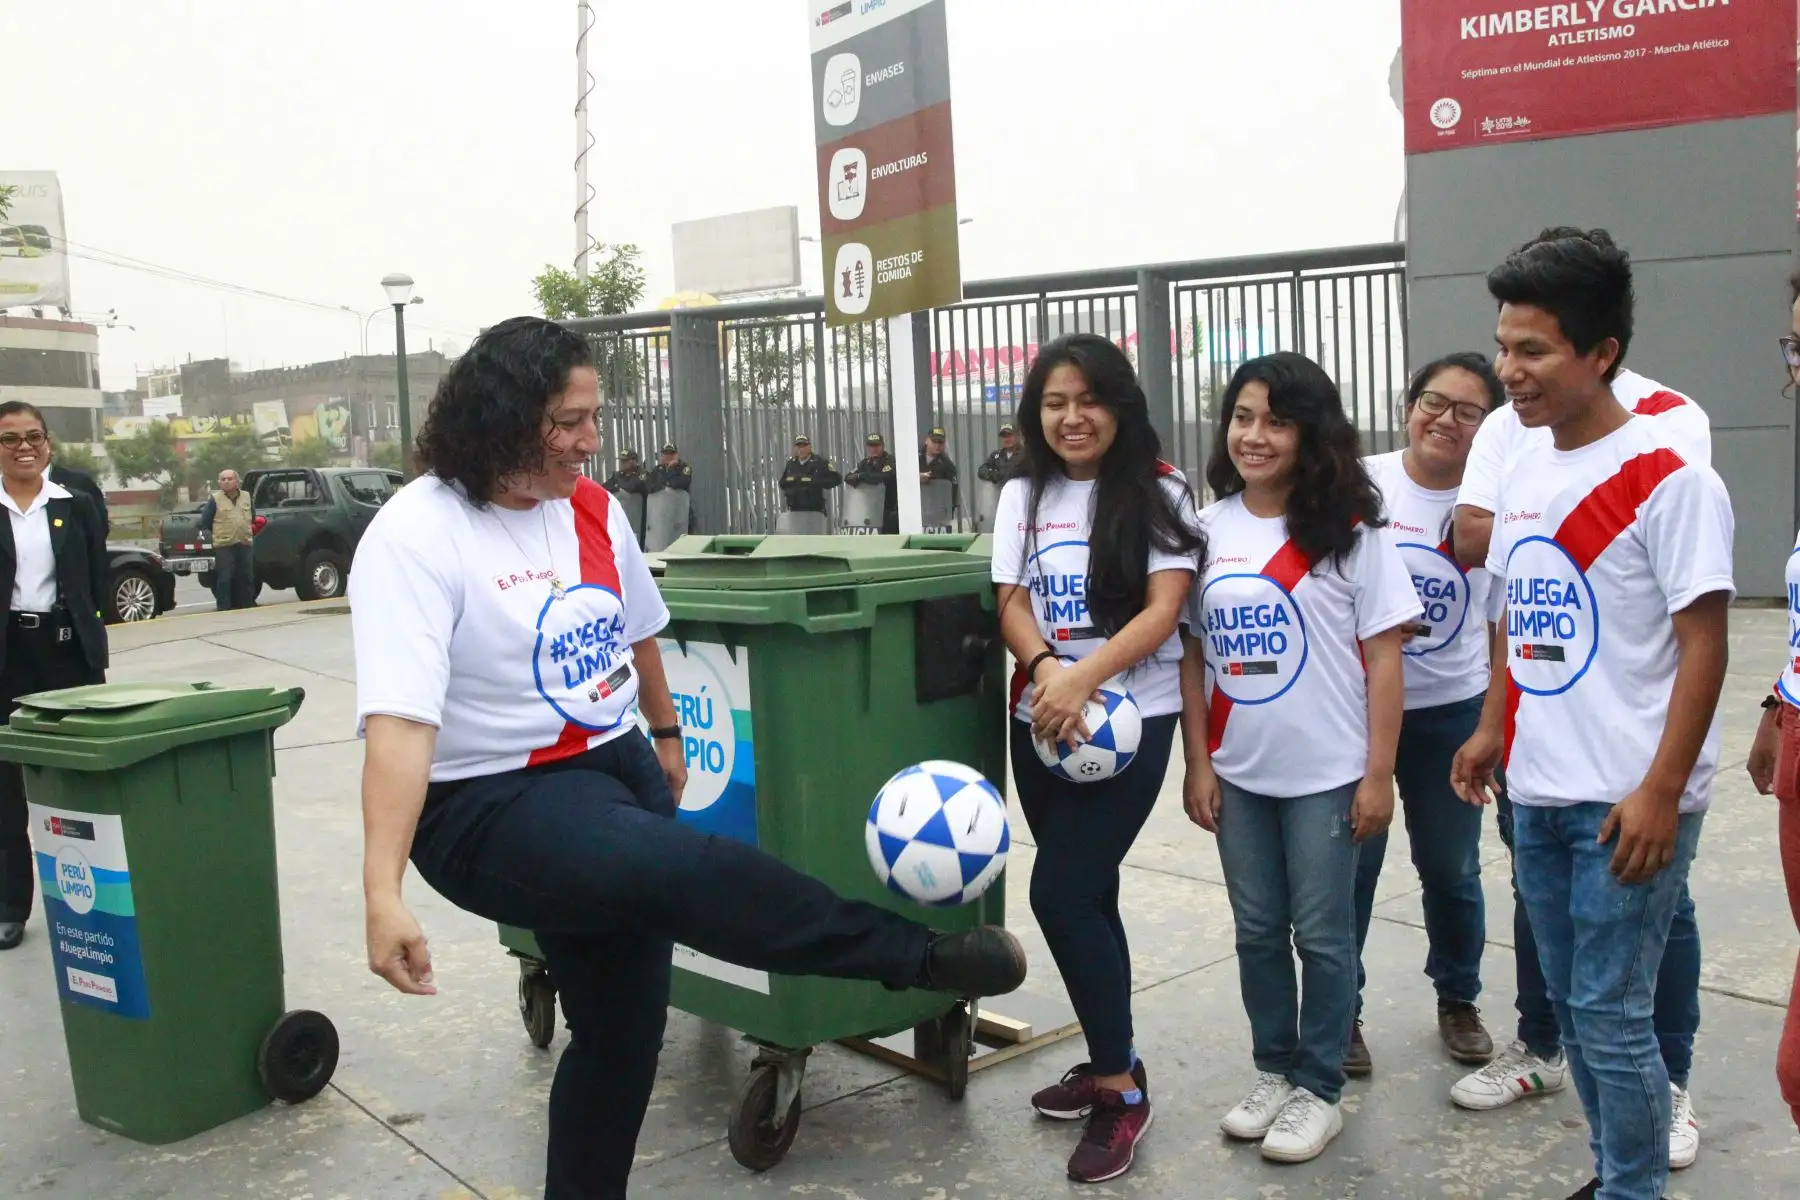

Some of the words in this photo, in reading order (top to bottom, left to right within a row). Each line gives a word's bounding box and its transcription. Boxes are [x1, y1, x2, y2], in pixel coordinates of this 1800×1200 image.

[1461, 0, 1604, 40] KIMBERLY
[1612, 0, 1730, 18] GAR
[1547, 24, 1636, 47] ATLETISMO
[1461, 66, 1498, 80] Séptima
[1500, 65, 1511, 74] en
[1513, 62, 1522, 73] el
[1523, 57, 1561, 72] Mundial
[1562, 56, 1575, 67] de
[1577, 51, 1621, 65] Atletismo
[1623, 47, 1647, 60] 2017
[1654, 42, 1690, 55] Marcha
[1691, 38, 1730, 52] Atlética
[866, 61, 904, 87] ENVASES
[871, 152, 928, 180] ENVOLTURAS
[876, 254, 910, 272] RESTOS
[911, 250, 923, 264] DE
[877, 267, 912, 284] COMIDA
[1394, 521, 1424, 534] PRIMERO
[1507, 578, 1581, 610] #JUEGA
[1207, 603, 1290, 632] #JUEGA
[1507, 610, 1576, 640] LIMPIO
[61, 862, 86, 881] PERÚ
[60, 879, 92, 899] LIMPIO
[56, 921, 67, 935] En
[67, 926, 83, 940] este
[84, 931, 114, 948] partido
[60, 940, 114, 964] #JuegaLimpio
